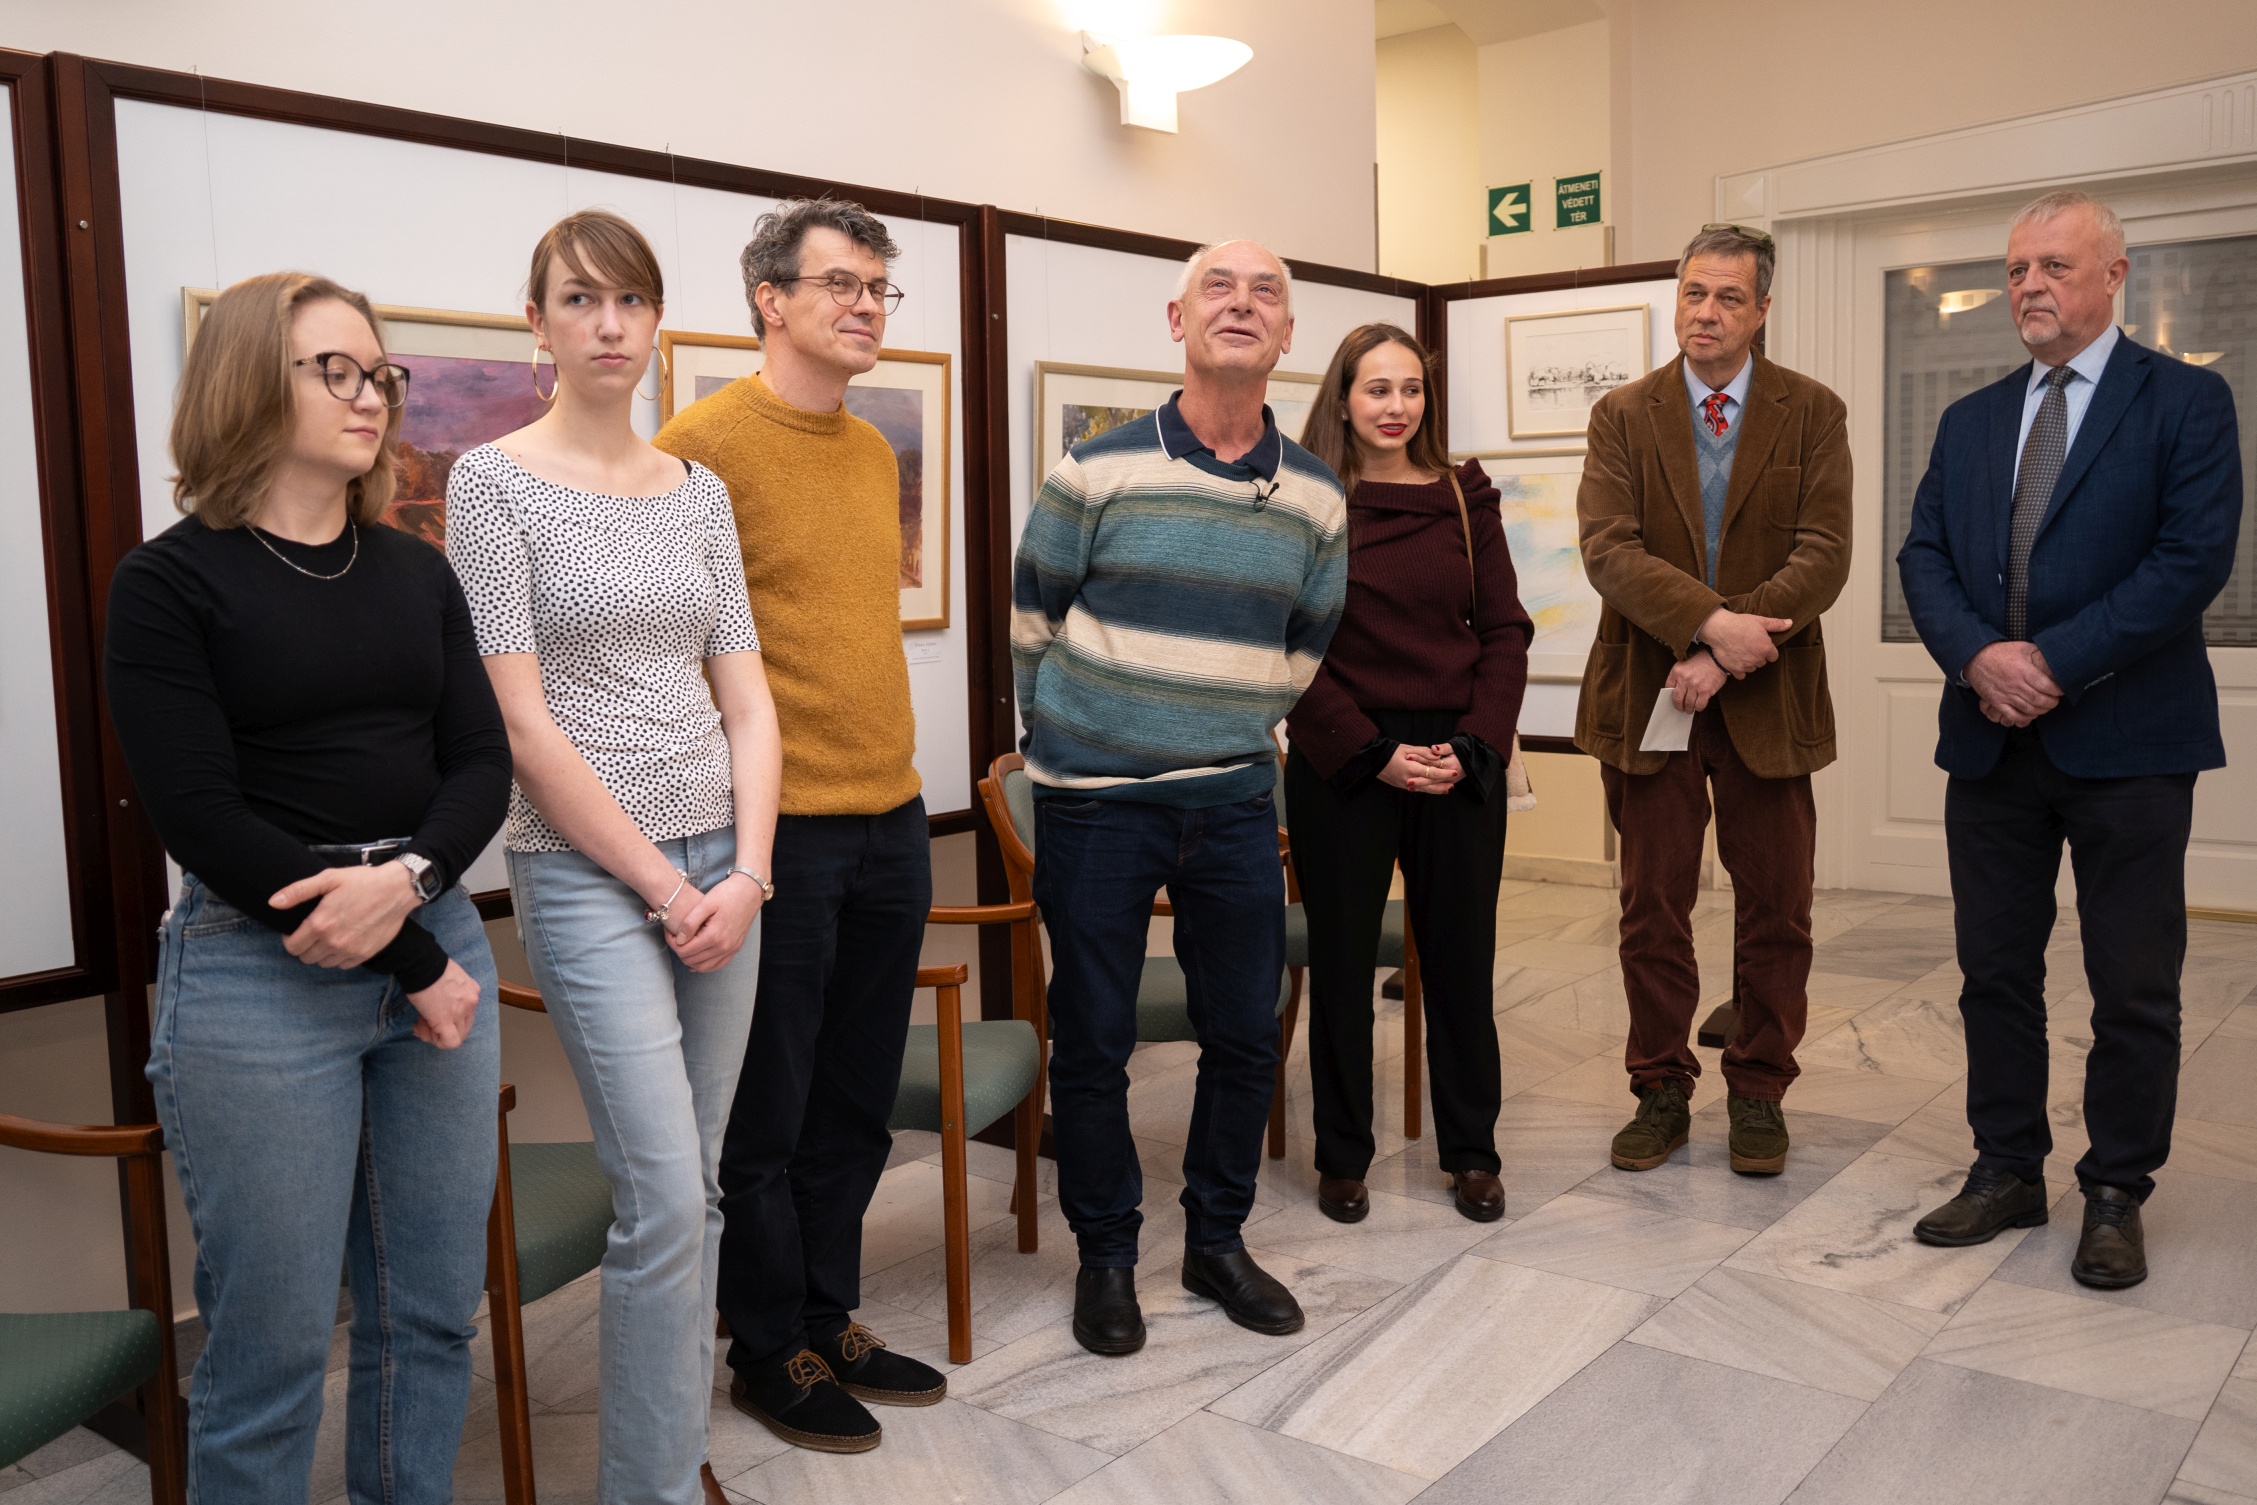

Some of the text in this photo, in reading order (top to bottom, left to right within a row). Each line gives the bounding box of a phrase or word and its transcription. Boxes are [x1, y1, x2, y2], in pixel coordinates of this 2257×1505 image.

[1557, 180, 1599, 195] ÁTMENETI
[1561, 195, 1595, 209] VÉDETT
[1570, 210, 1587, 222] TÉR
